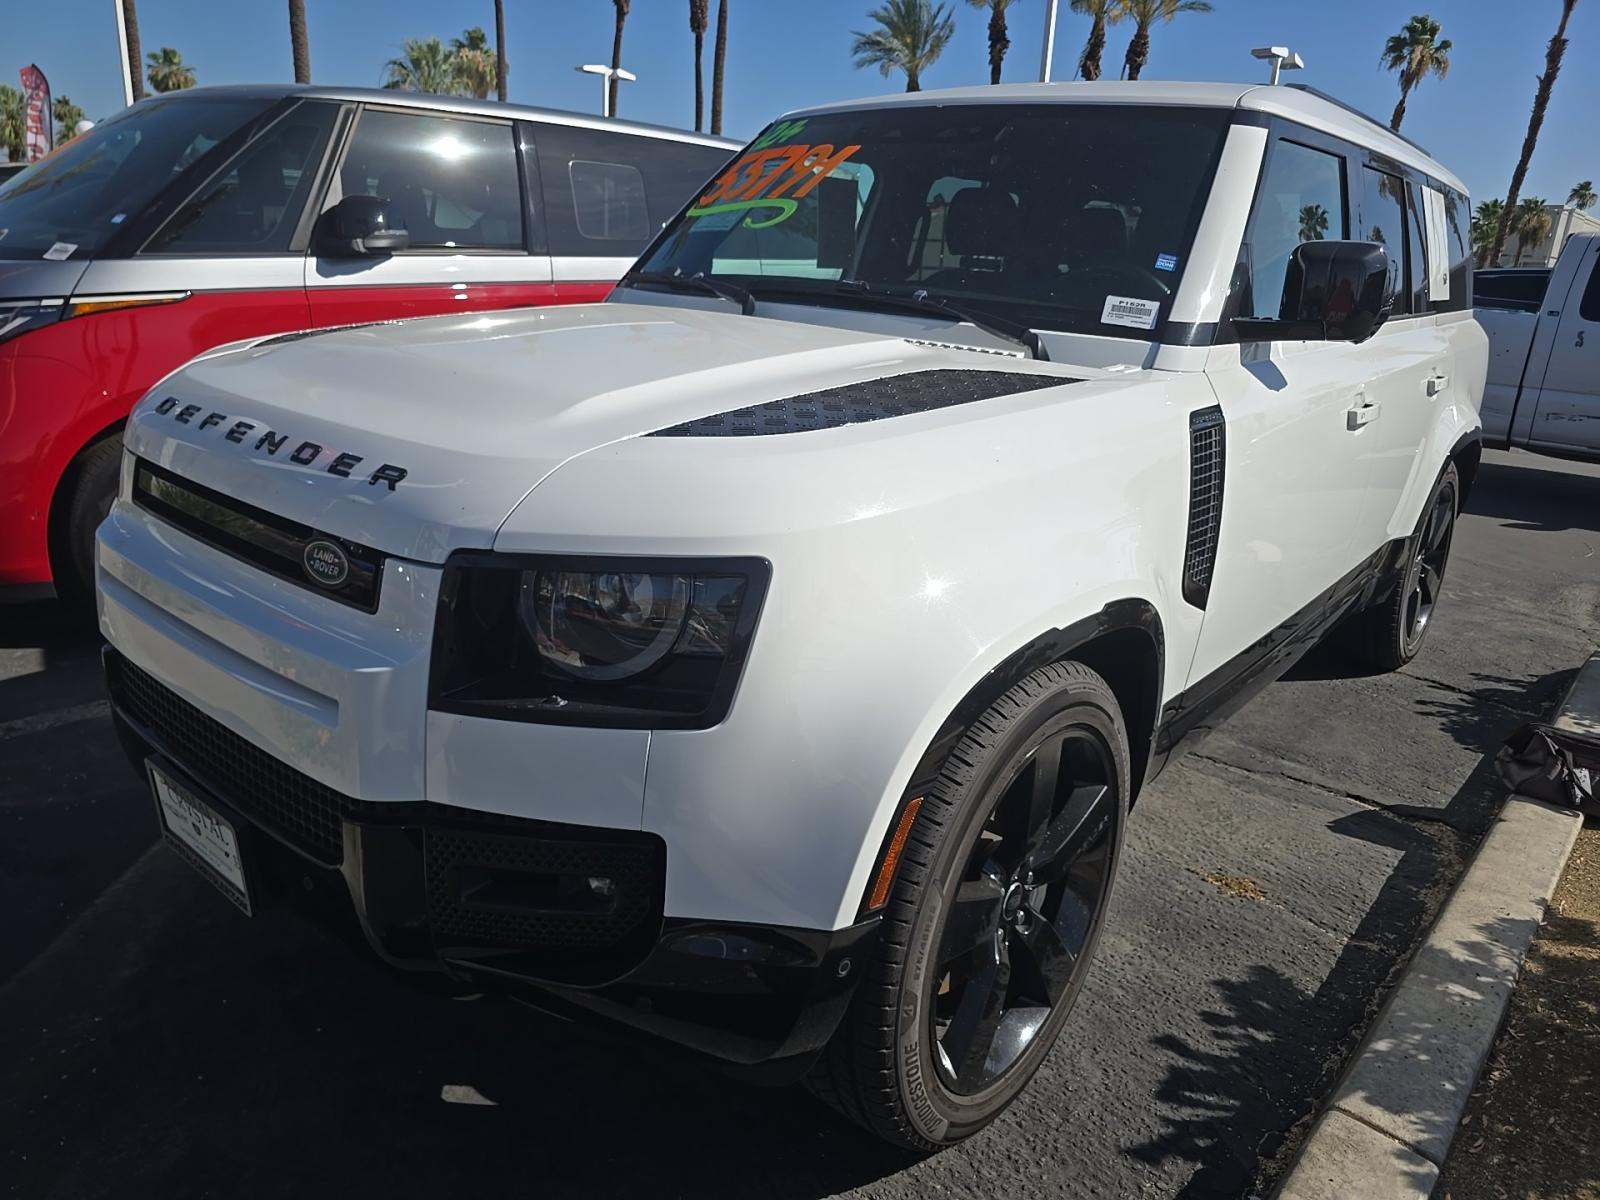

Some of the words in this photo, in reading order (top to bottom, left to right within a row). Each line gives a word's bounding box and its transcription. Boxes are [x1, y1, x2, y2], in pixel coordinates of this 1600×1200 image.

[154, 396, 409, 492] DEFENDER
[312, 548, 336, 565] LAND
[313, 560, 340, 577] ROVER
[904, 1040, 943, 1134] BRIDGESTONE
